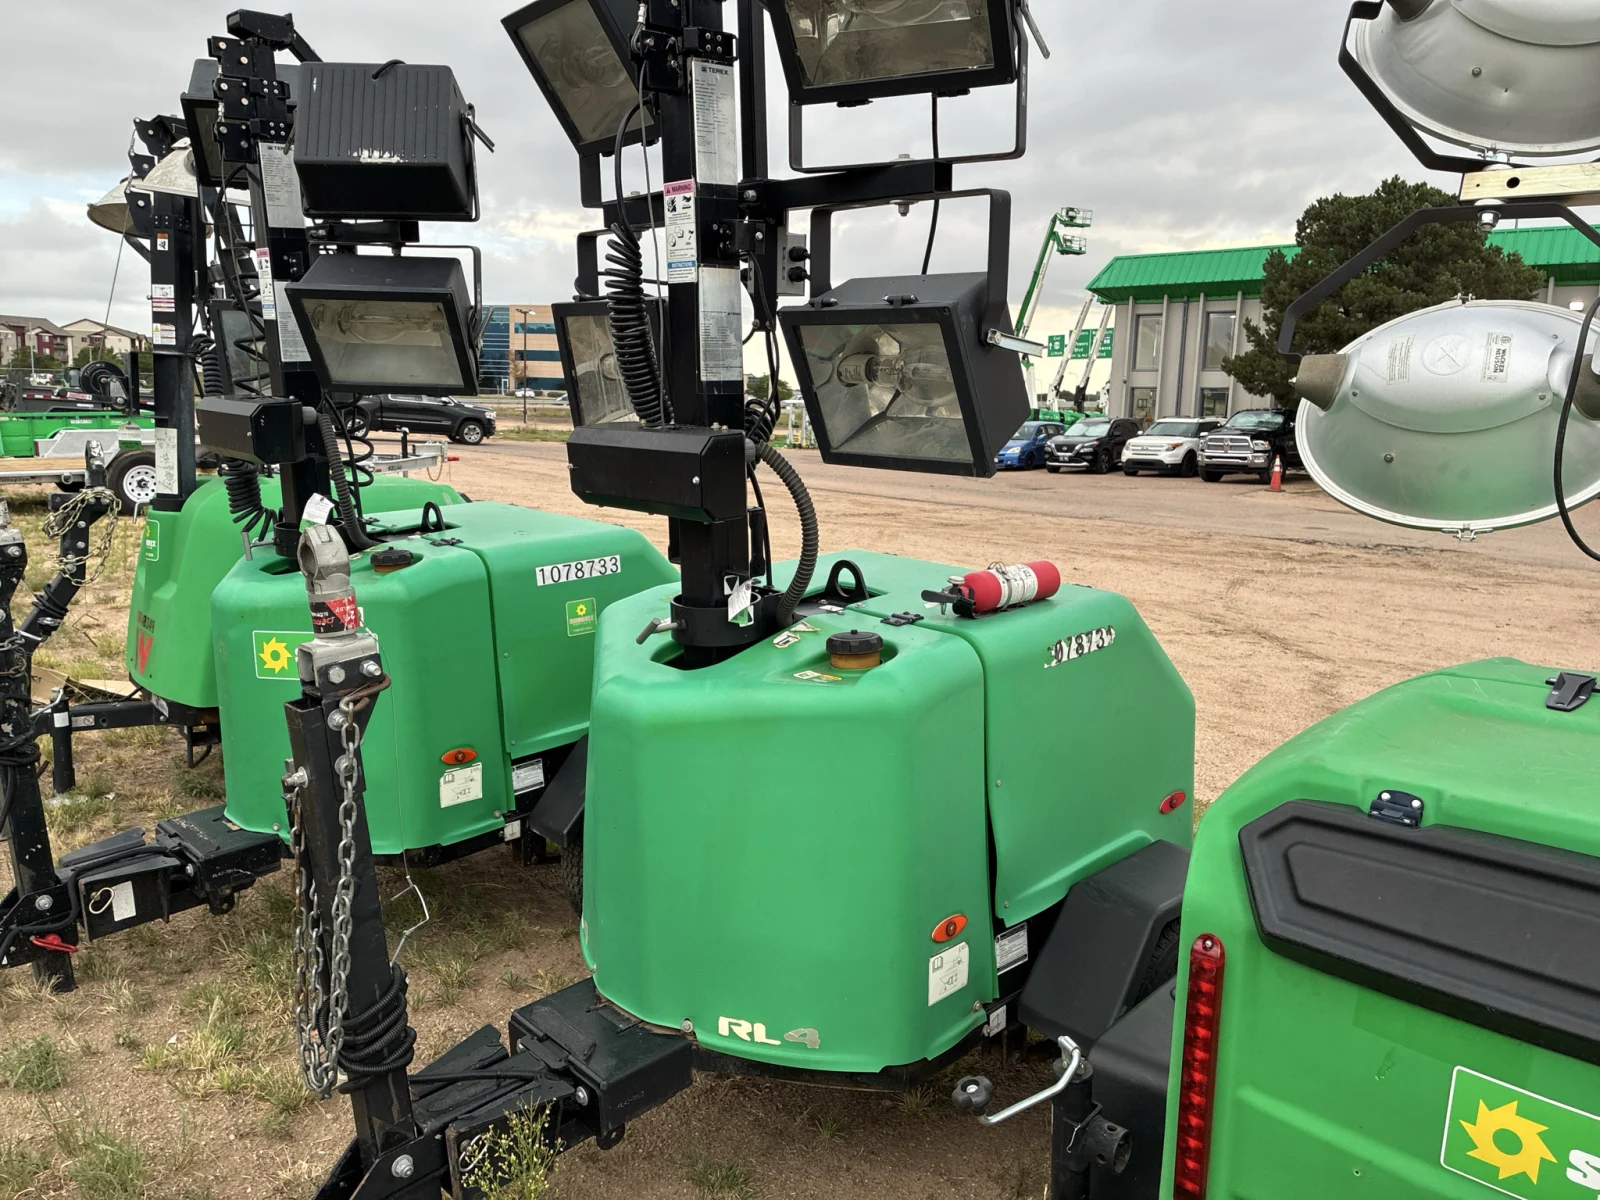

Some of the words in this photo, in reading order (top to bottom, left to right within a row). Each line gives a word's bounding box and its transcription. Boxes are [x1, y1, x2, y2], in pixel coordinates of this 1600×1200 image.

[708, 67, 729, 76] TEREX
[672, 184, 692, 193] WARNING
[538, 556, 619, 585] 1078733
